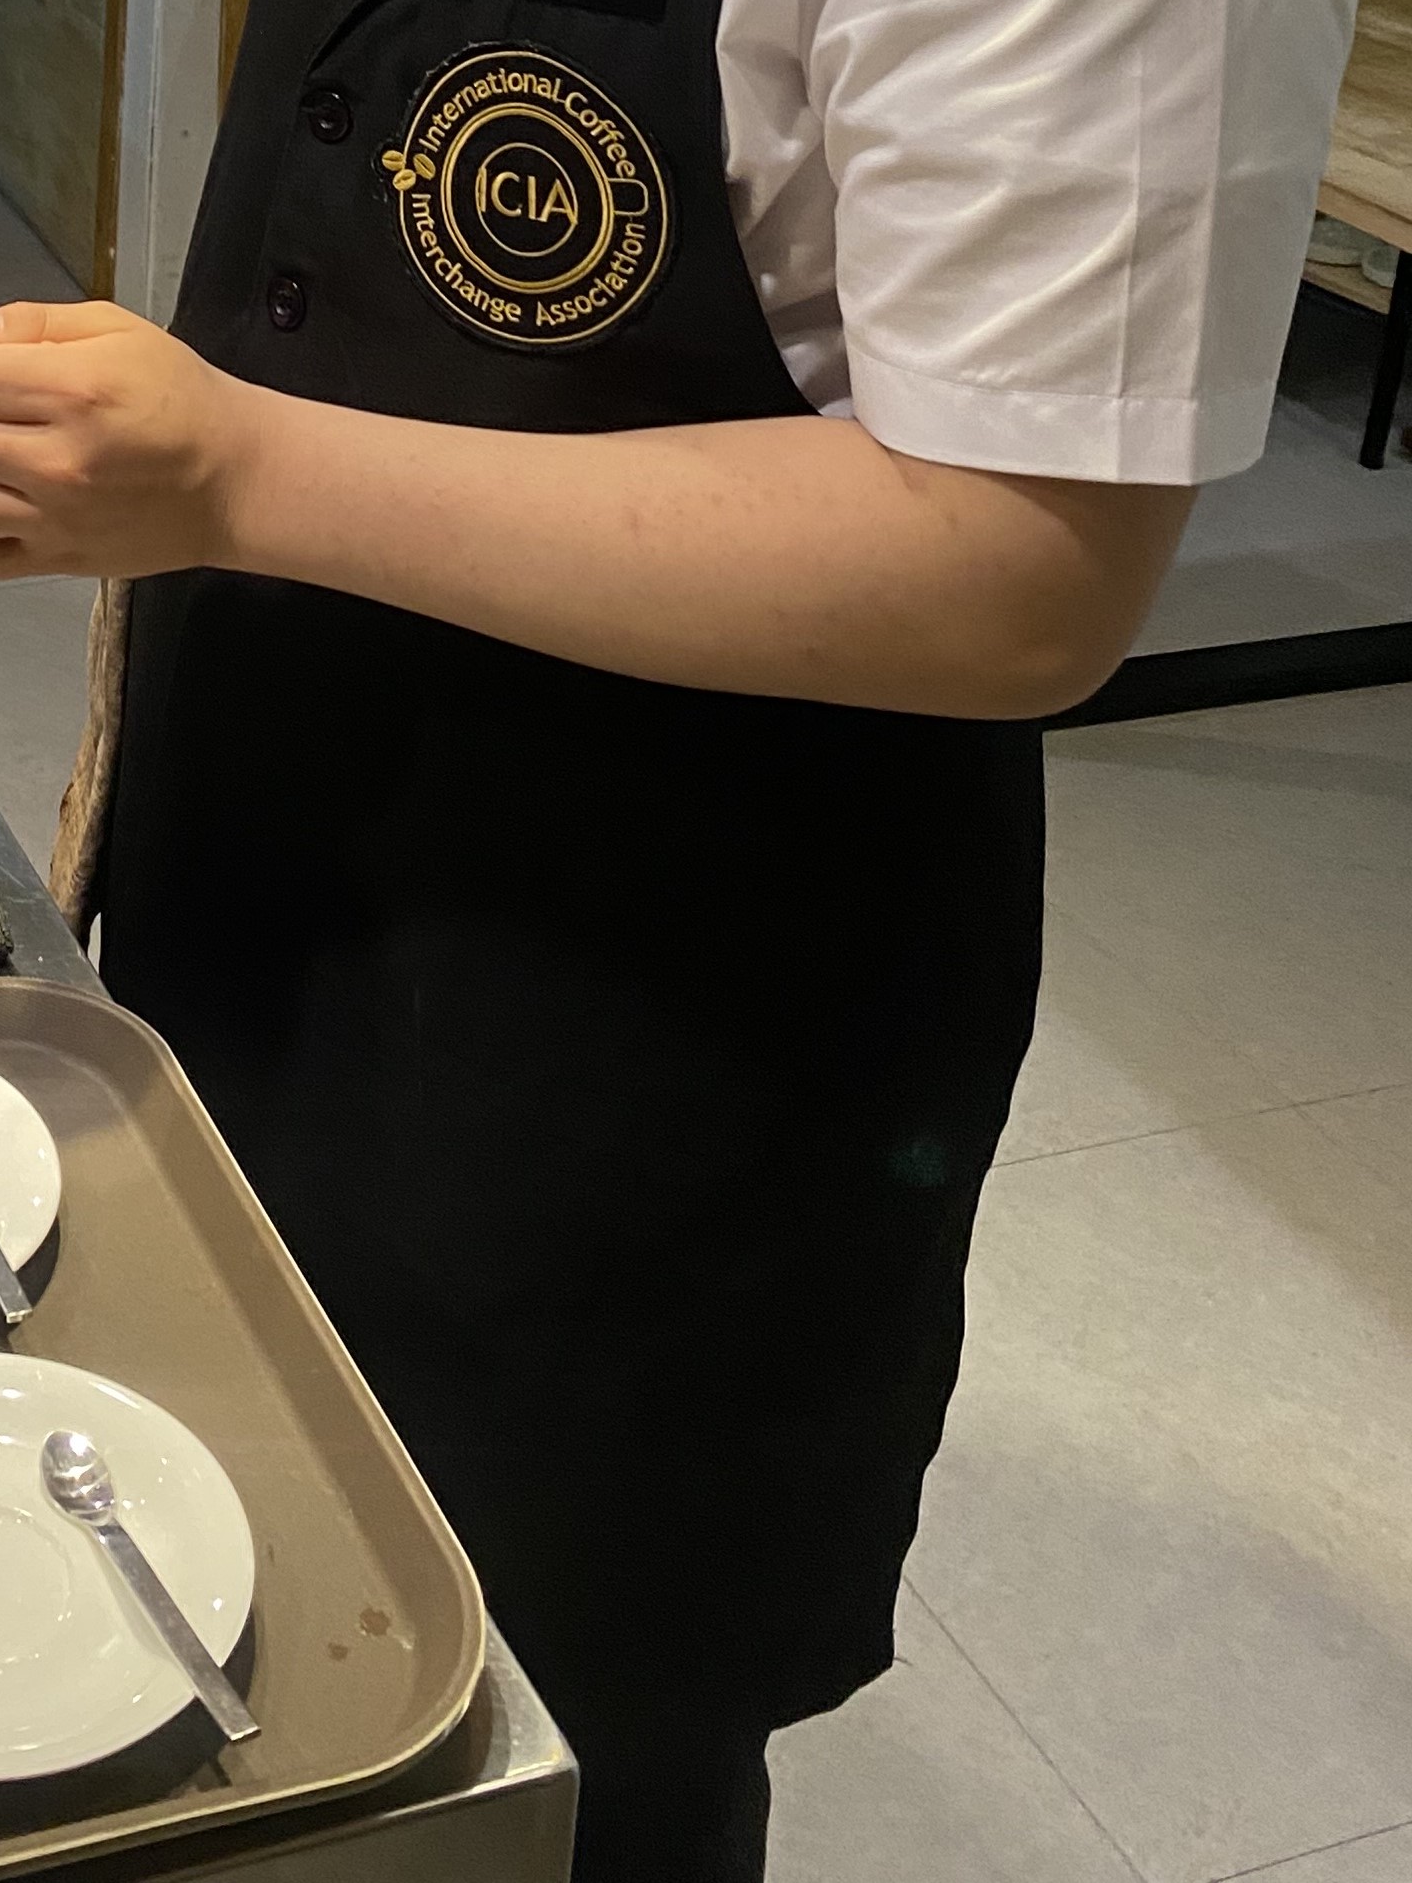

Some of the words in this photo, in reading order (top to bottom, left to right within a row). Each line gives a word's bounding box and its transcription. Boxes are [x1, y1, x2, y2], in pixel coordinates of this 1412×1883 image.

[420, 68, 564, 152] International
[565, 92, 635, 178] Coffee
[477, 167, 578, 224] ICIA
[412, 193, 522, 322] Interchange
[536, 223, 645, 326] Association
